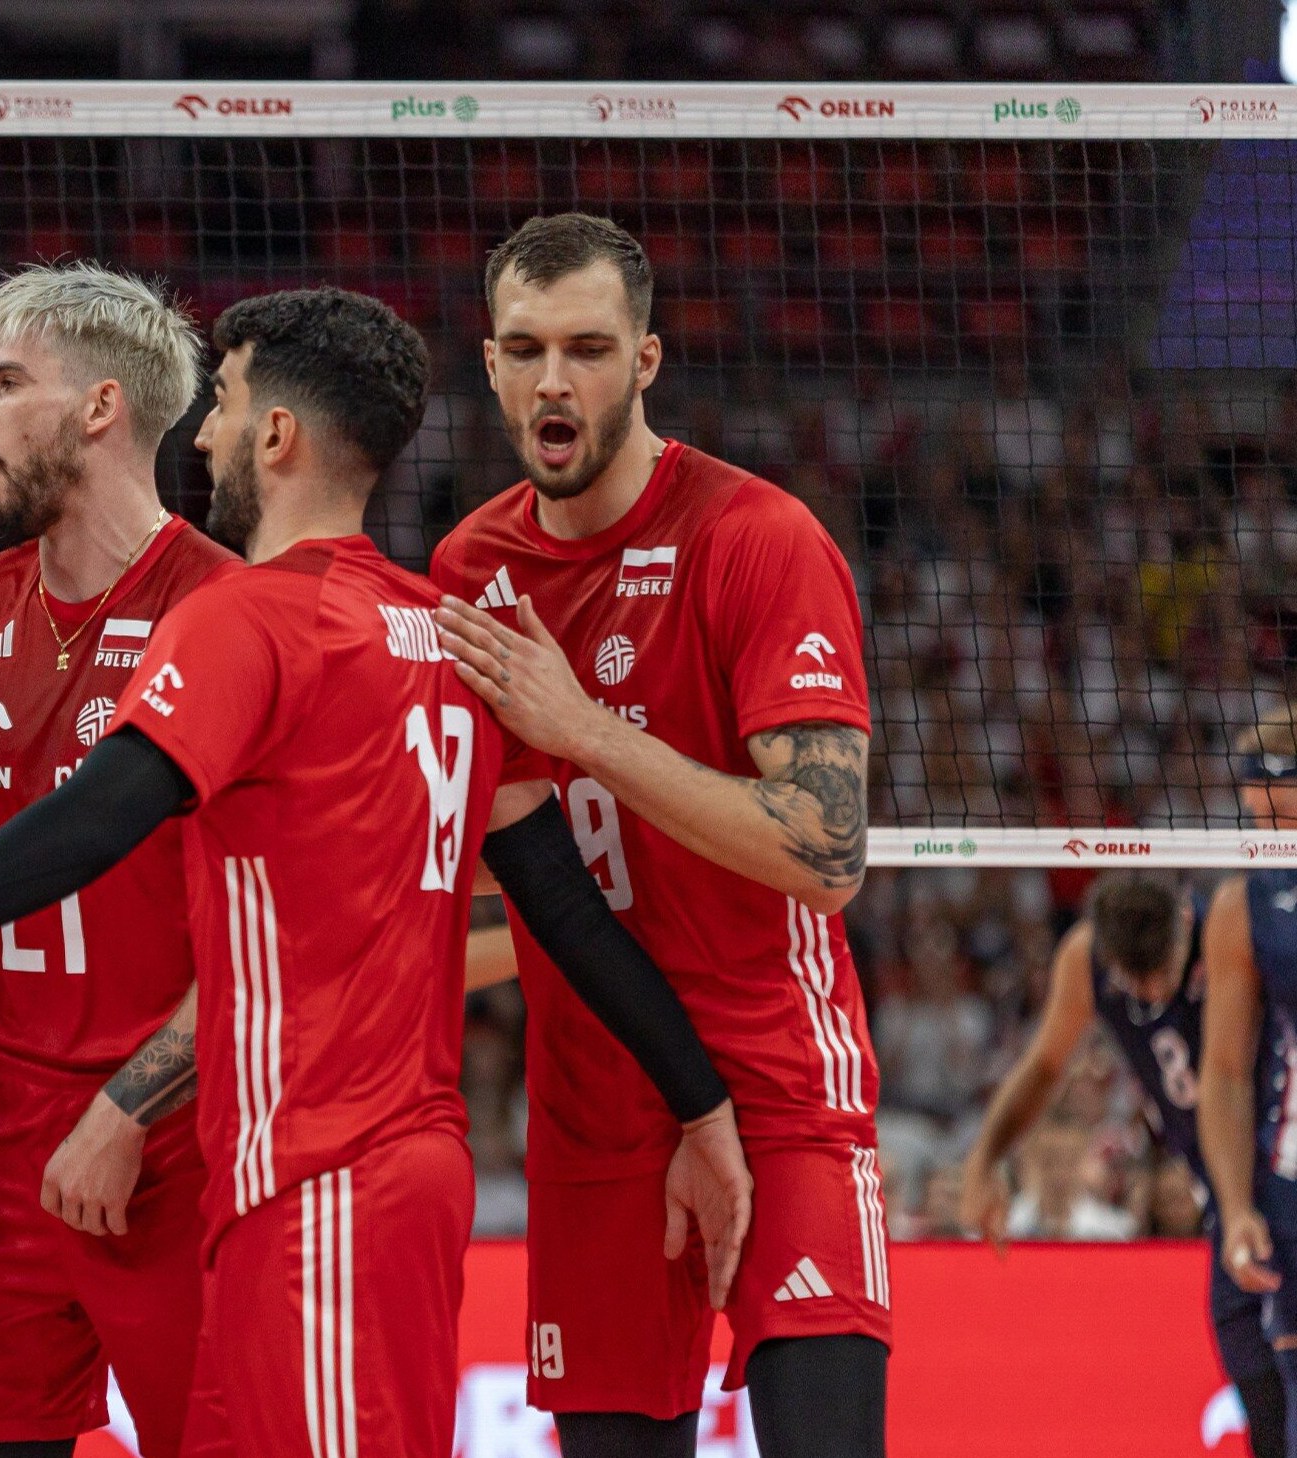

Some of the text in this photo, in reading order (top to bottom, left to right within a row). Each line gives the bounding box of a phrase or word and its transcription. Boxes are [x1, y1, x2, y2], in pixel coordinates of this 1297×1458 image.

[216, 98, 291, 115] ORLEN
[391, 96, 446, 121] plus
[820, 100, 895, 117] ORLEN
[994, 98, 1048, 122] plus
[1220, 101, 1277, 112] POLSKA
[615, 581, 672, 597] POLSKA
[95, 652, 145, 668] POLSK
[790, 672, 842, 691] ORLEN
[141, 688, 175, 717] LEN
[406, 704, 474, 894] 19
[552, 777, 634, 912] 9
[914, 840, 953, 857] plus
[1094, 843, 1151, 855] ORLEN
